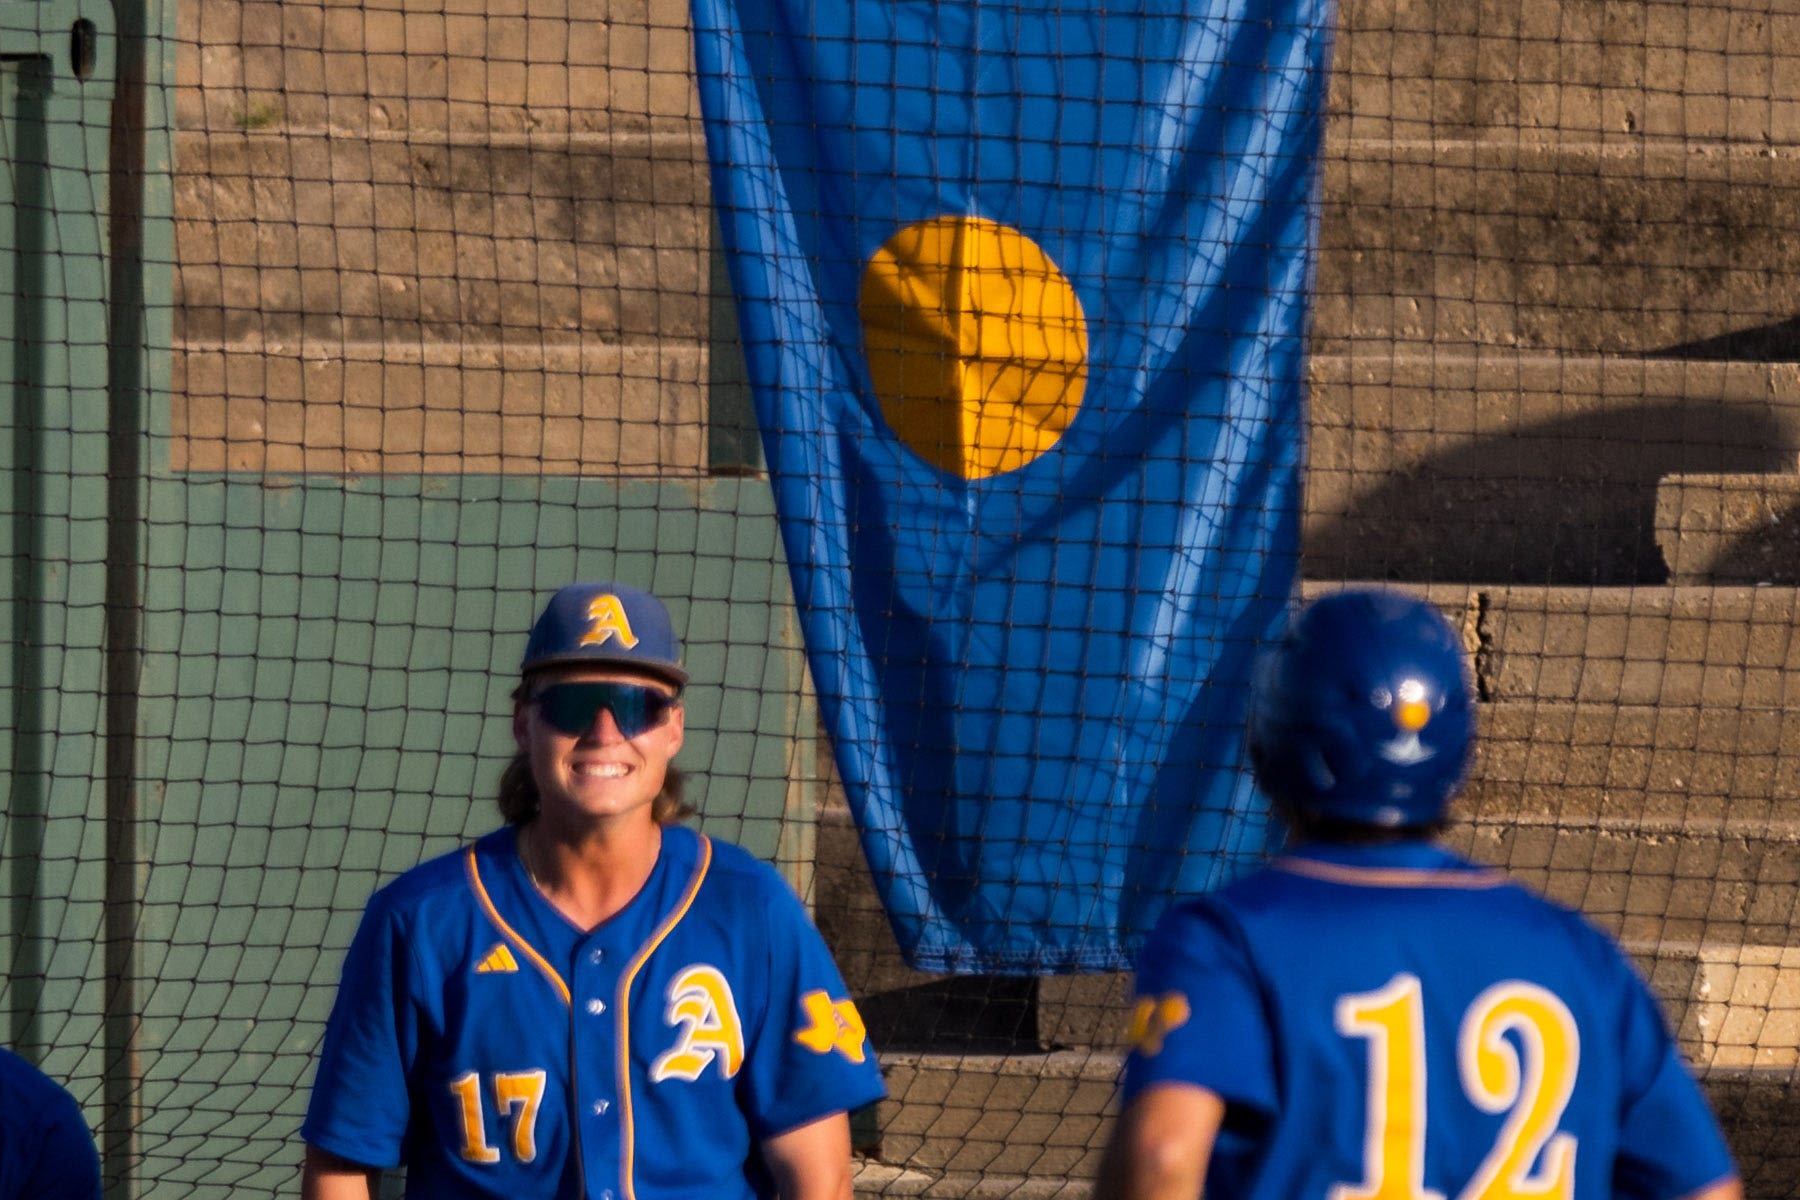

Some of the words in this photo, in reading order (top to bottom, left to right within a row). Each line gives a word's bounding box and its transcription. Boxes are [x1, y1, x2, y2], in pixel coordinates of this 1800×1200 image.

[579, 593, 640, 650] A
[652, 964, 745, 1083] A
[450, 1069, 547, 1164] 17
